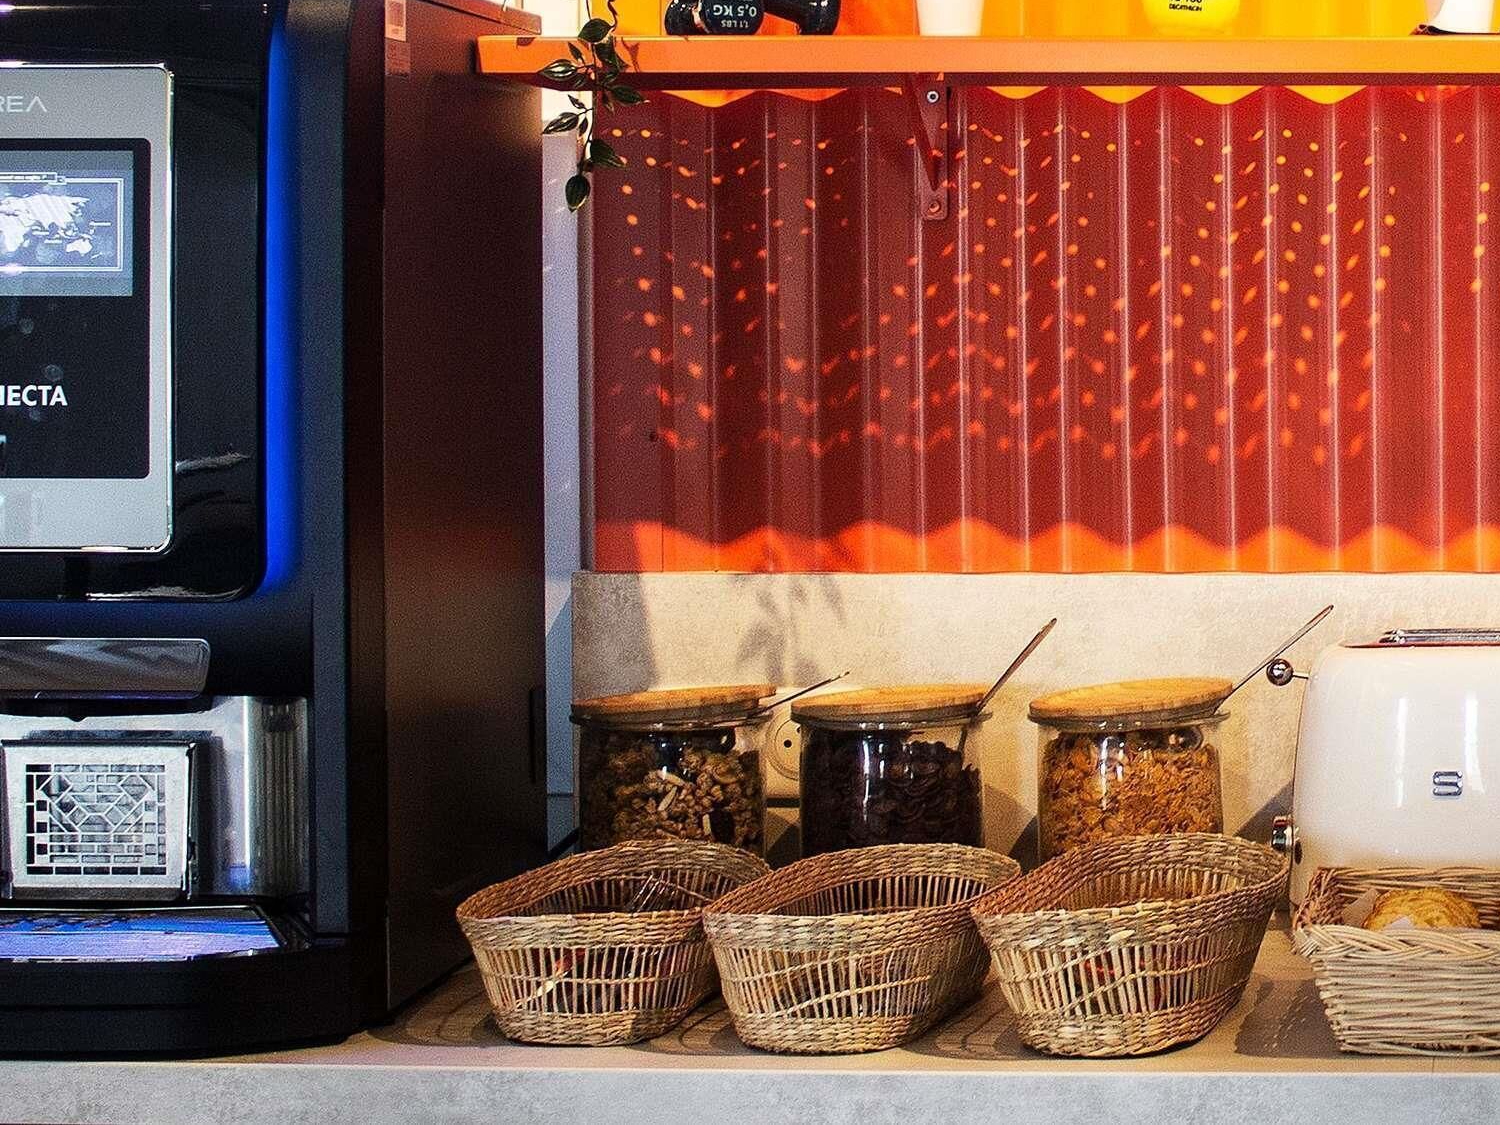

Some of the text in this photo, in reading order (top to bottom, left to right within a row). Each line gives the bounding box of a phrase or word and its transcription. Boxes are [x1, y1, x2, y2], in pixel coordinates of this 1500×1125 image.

[713, 3, 758, 18] 0,5 KG
[721, 19, 738, 29] LBS
